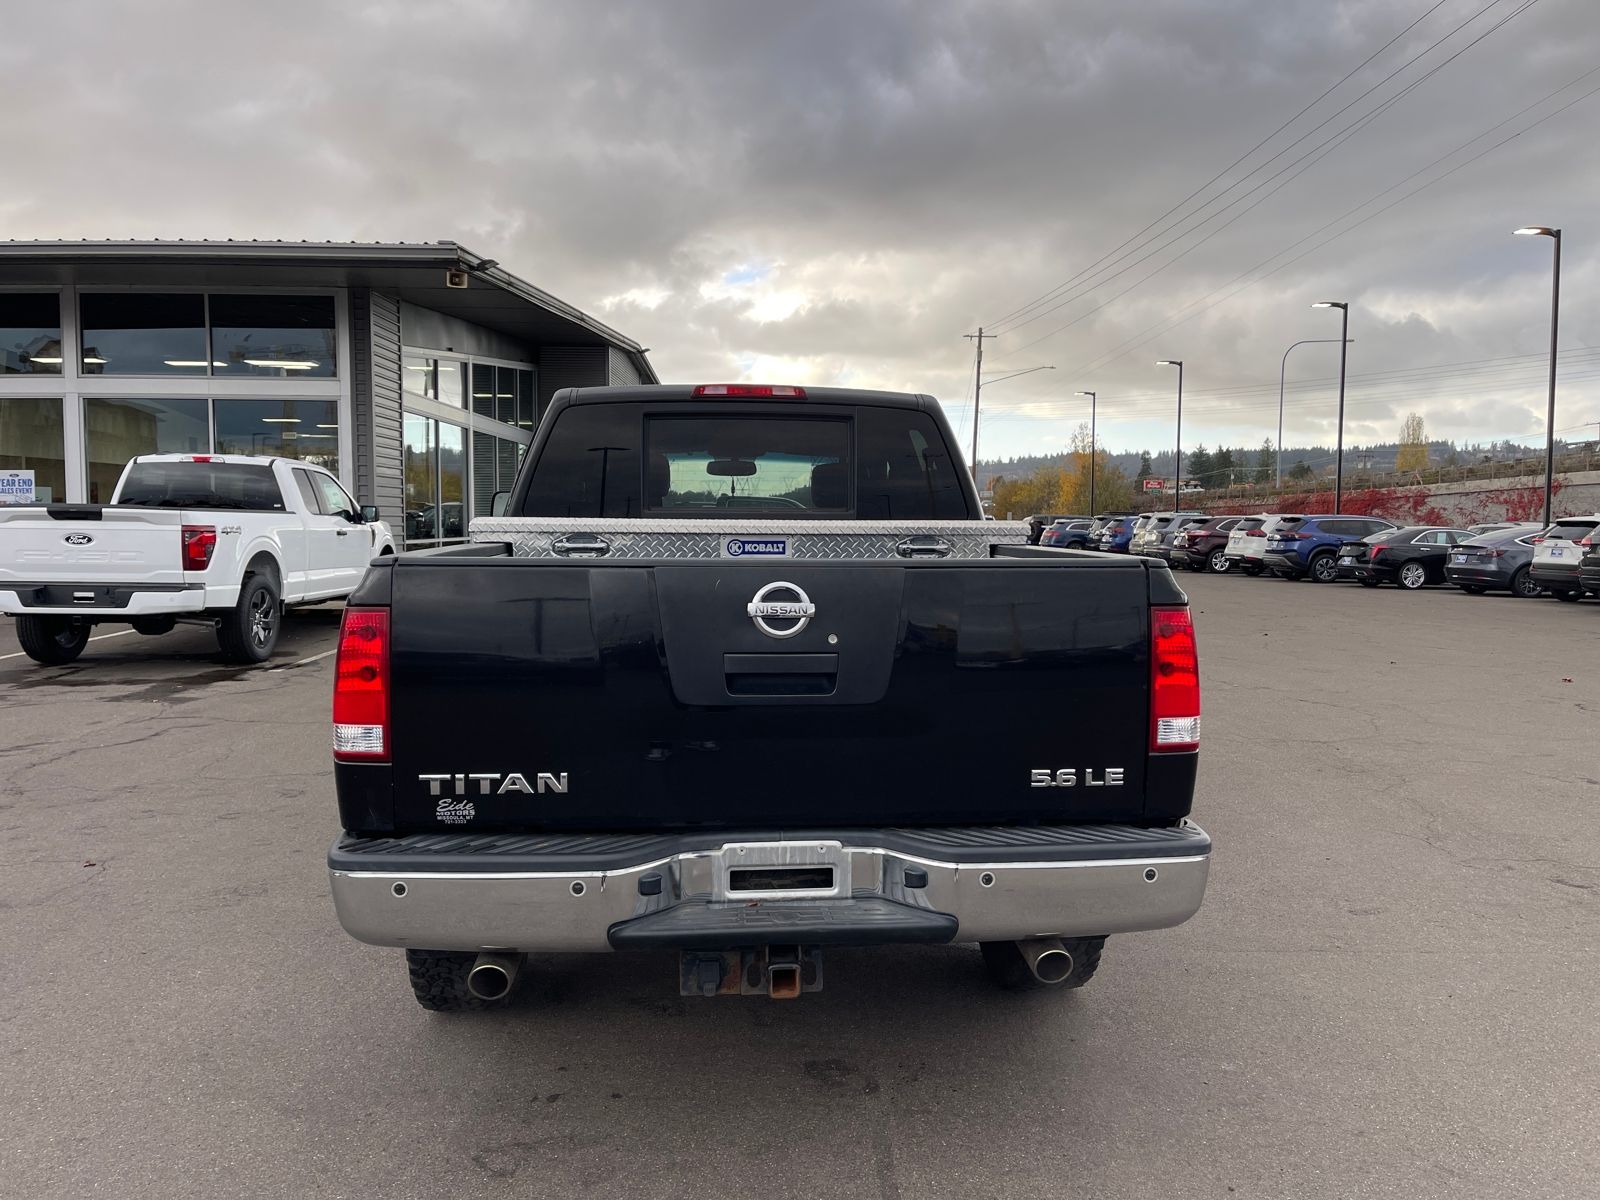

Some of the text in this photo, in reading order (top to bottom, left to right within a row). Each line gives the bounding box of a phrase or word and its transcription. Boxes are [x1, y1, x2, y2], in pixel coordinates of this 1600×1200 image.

[0, 478, 33, 488] EAR END
[69, 535, 88, 544] Ford
[744, 543, 785, 552] KOBALT
[755, 605, 808, 615] NISSAN
[1031, 768, 1124, 787] 5.6 LE
[418, 772, 568, 796] TITAN
[436, 798, 475, 812] Eide
